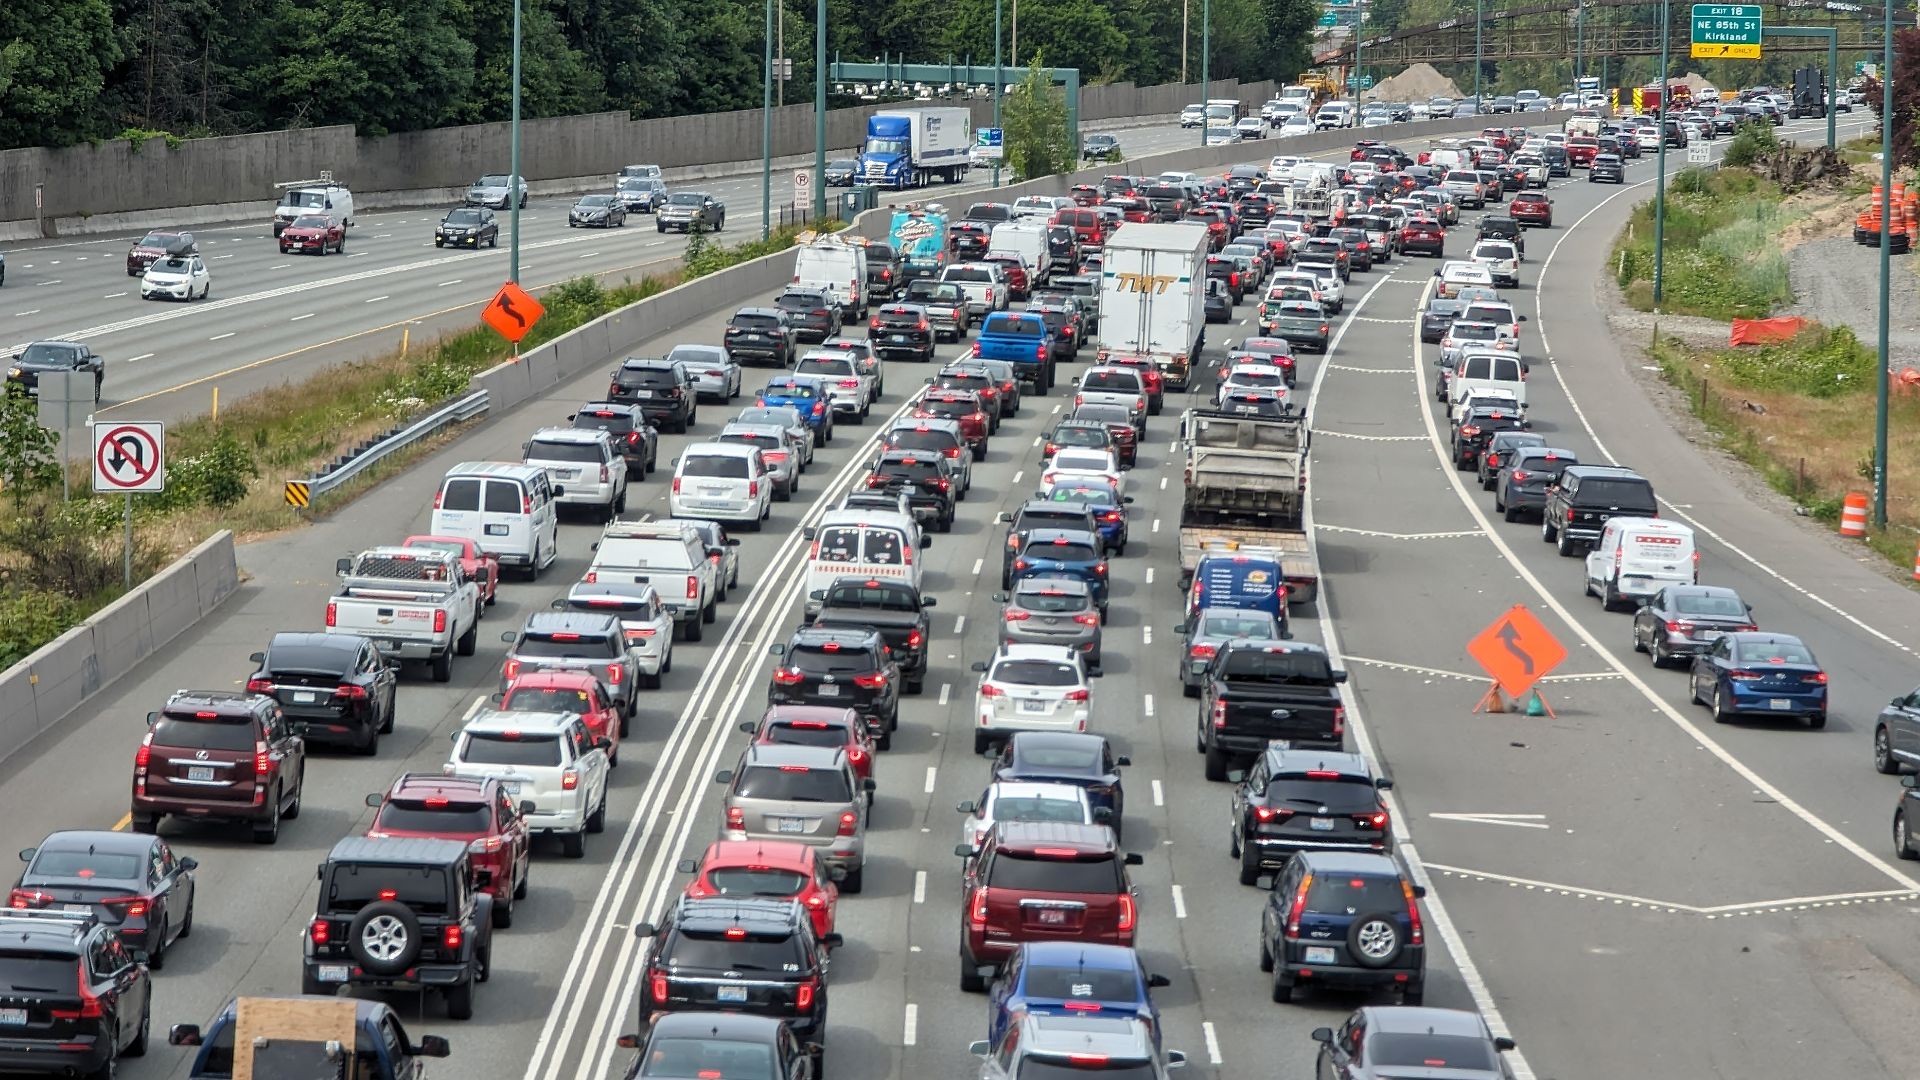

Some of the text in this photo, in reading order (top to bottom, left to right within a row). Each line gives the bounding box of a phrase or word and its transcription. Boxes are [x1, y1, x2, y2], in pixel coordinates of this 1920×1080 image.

[1731, 7, 1743, 15] 18
[1697, 21, 1756, 30] NE 85th St
[1705, 33, 1747, 41] Kirkland
